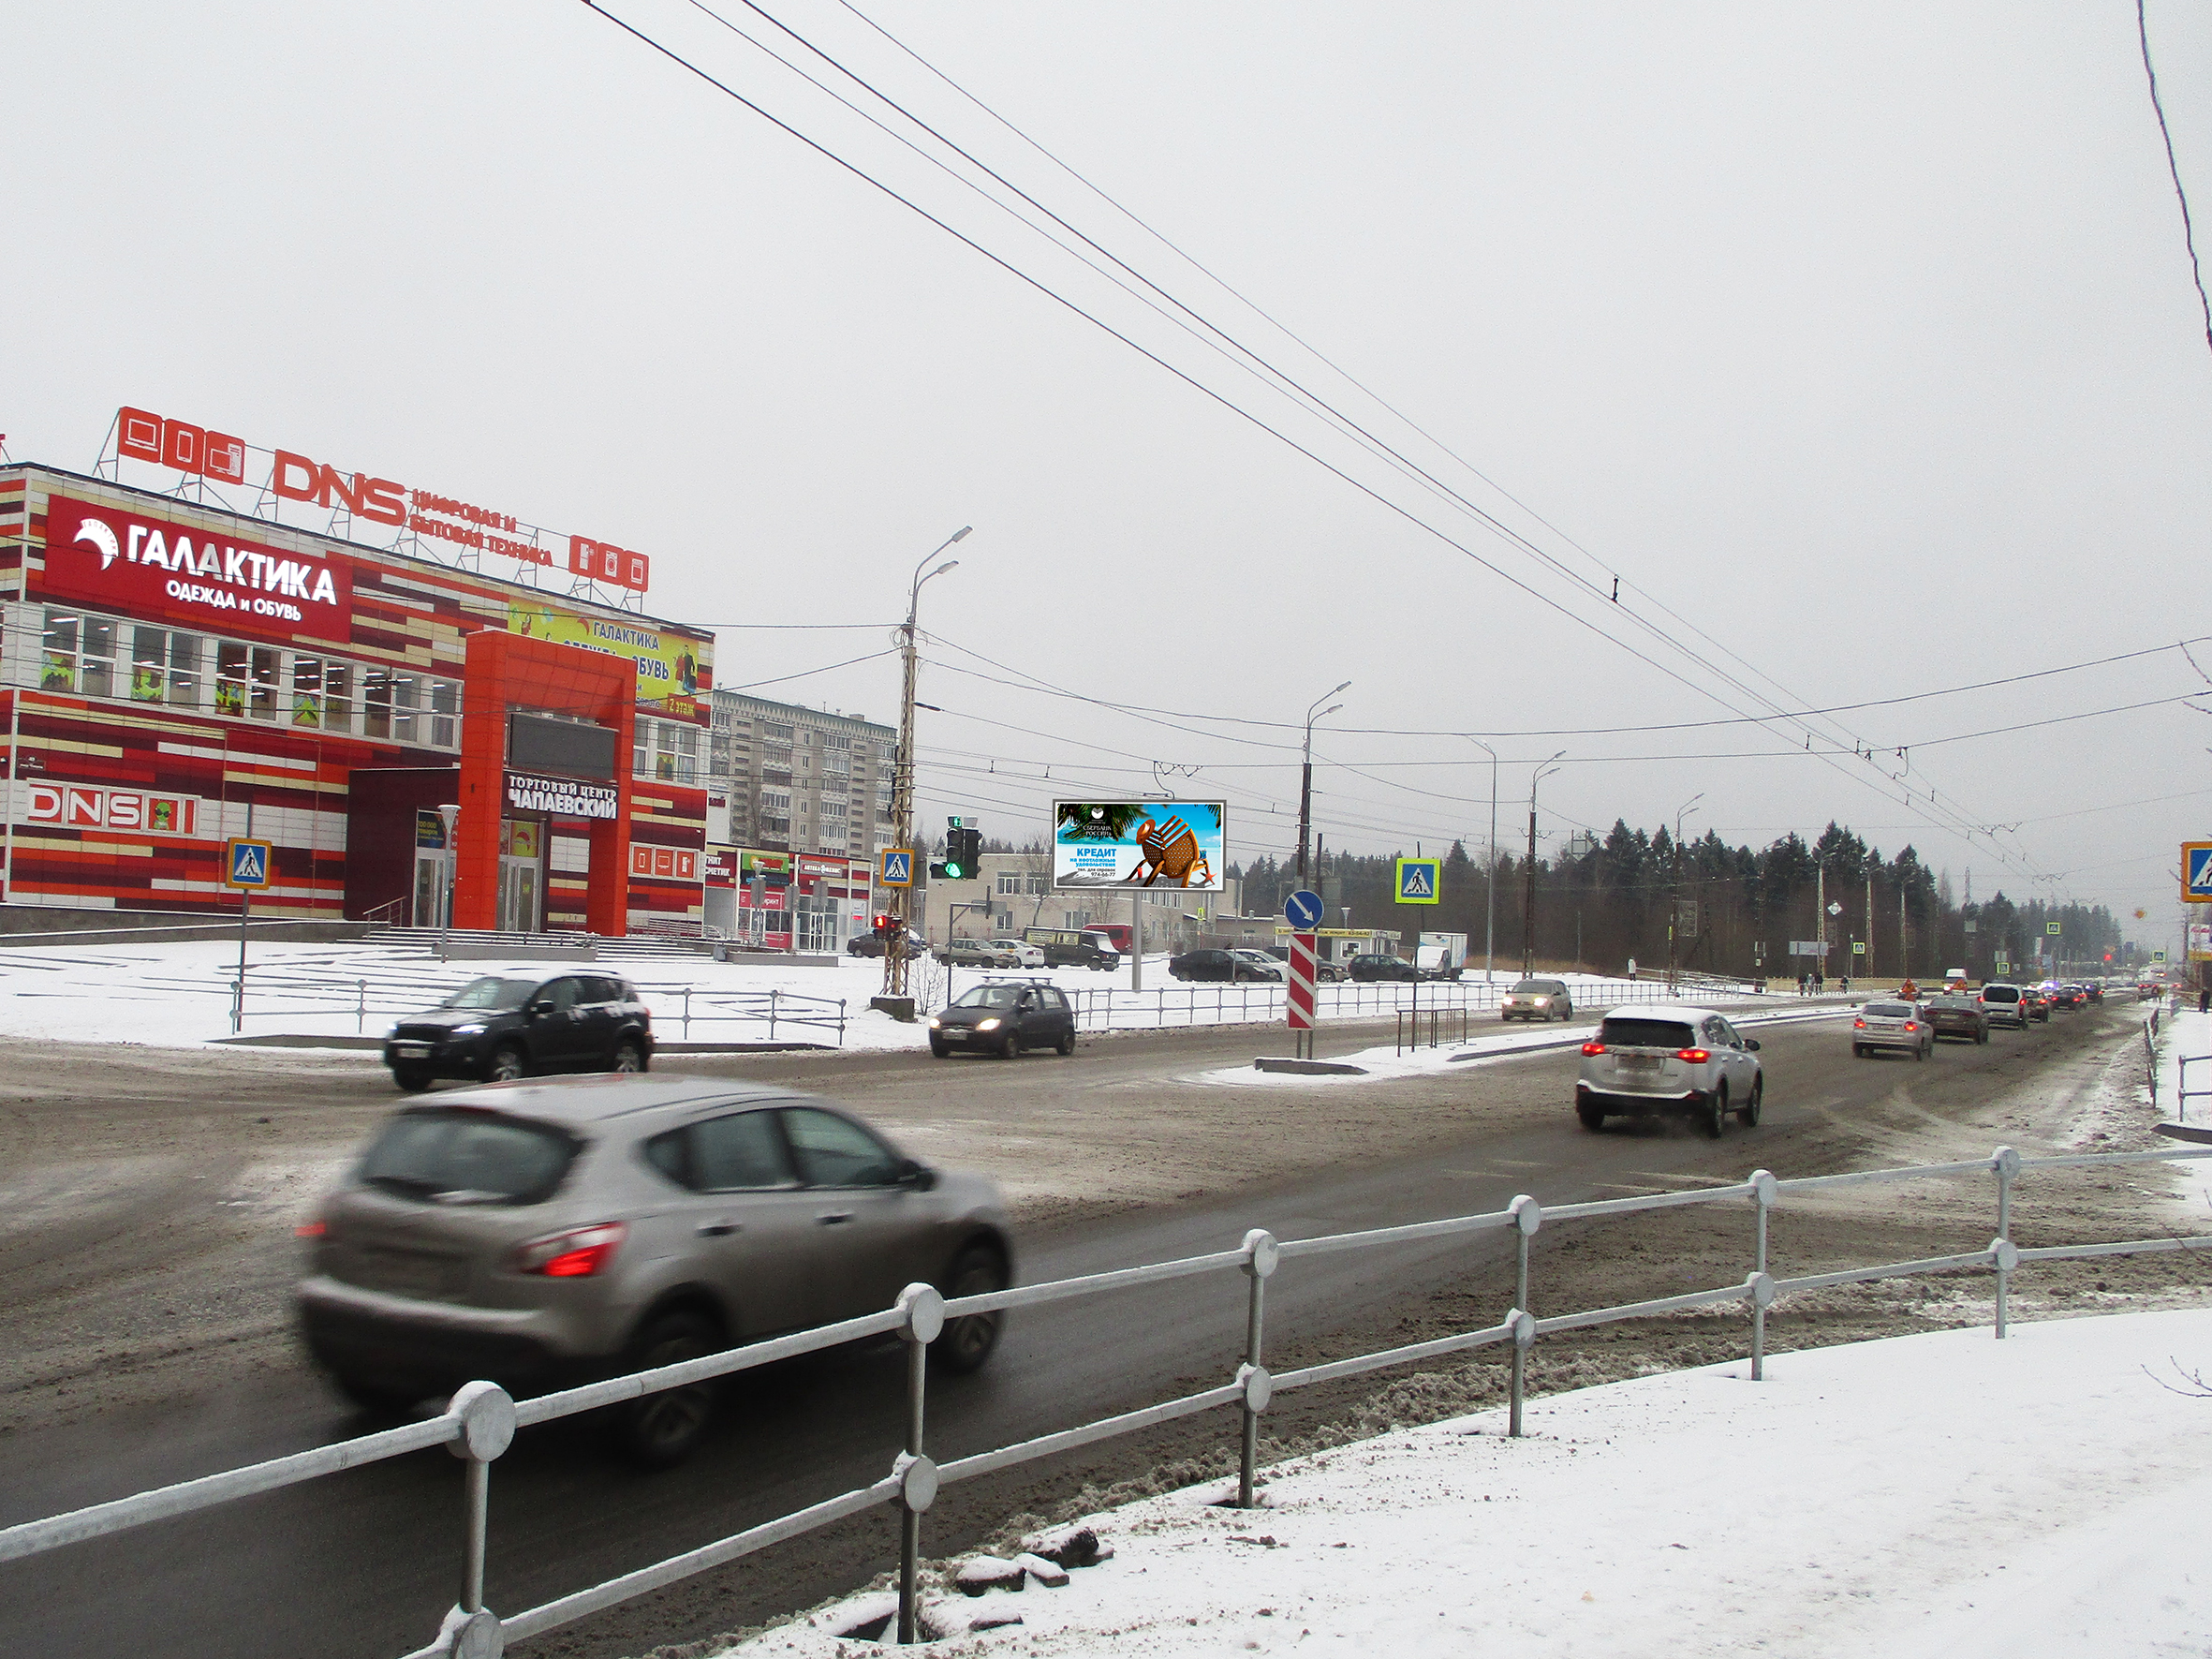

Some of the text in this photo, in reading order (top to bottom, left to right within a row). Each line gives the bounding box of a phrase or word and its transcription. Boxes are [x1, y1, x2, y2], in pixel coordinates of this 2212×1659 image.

[273, 449, 406, 526] DNS
[410, 514, 553, 568] БЫТОВАЯ ТЕХНИКА
[126, 524, 338, 606] ГАЛАКТИКА
[165, 579, 236, 609] ОДЕЖДА
[254, 598, 302, 622] ОБУВЬ
[593, 621, 660, 651] ГАЛАКТИКА
[669, 698, 675, 712] 2
[28, 786, 140, 825] DNS
[508, 788, 617, 819] ЧАПАЕВСКИЙ
[509, 775, 617, 801] ТОРГОВЫЙ ЦЕНТР
[1076, 848, 1116, 858] КРЕДИТ
